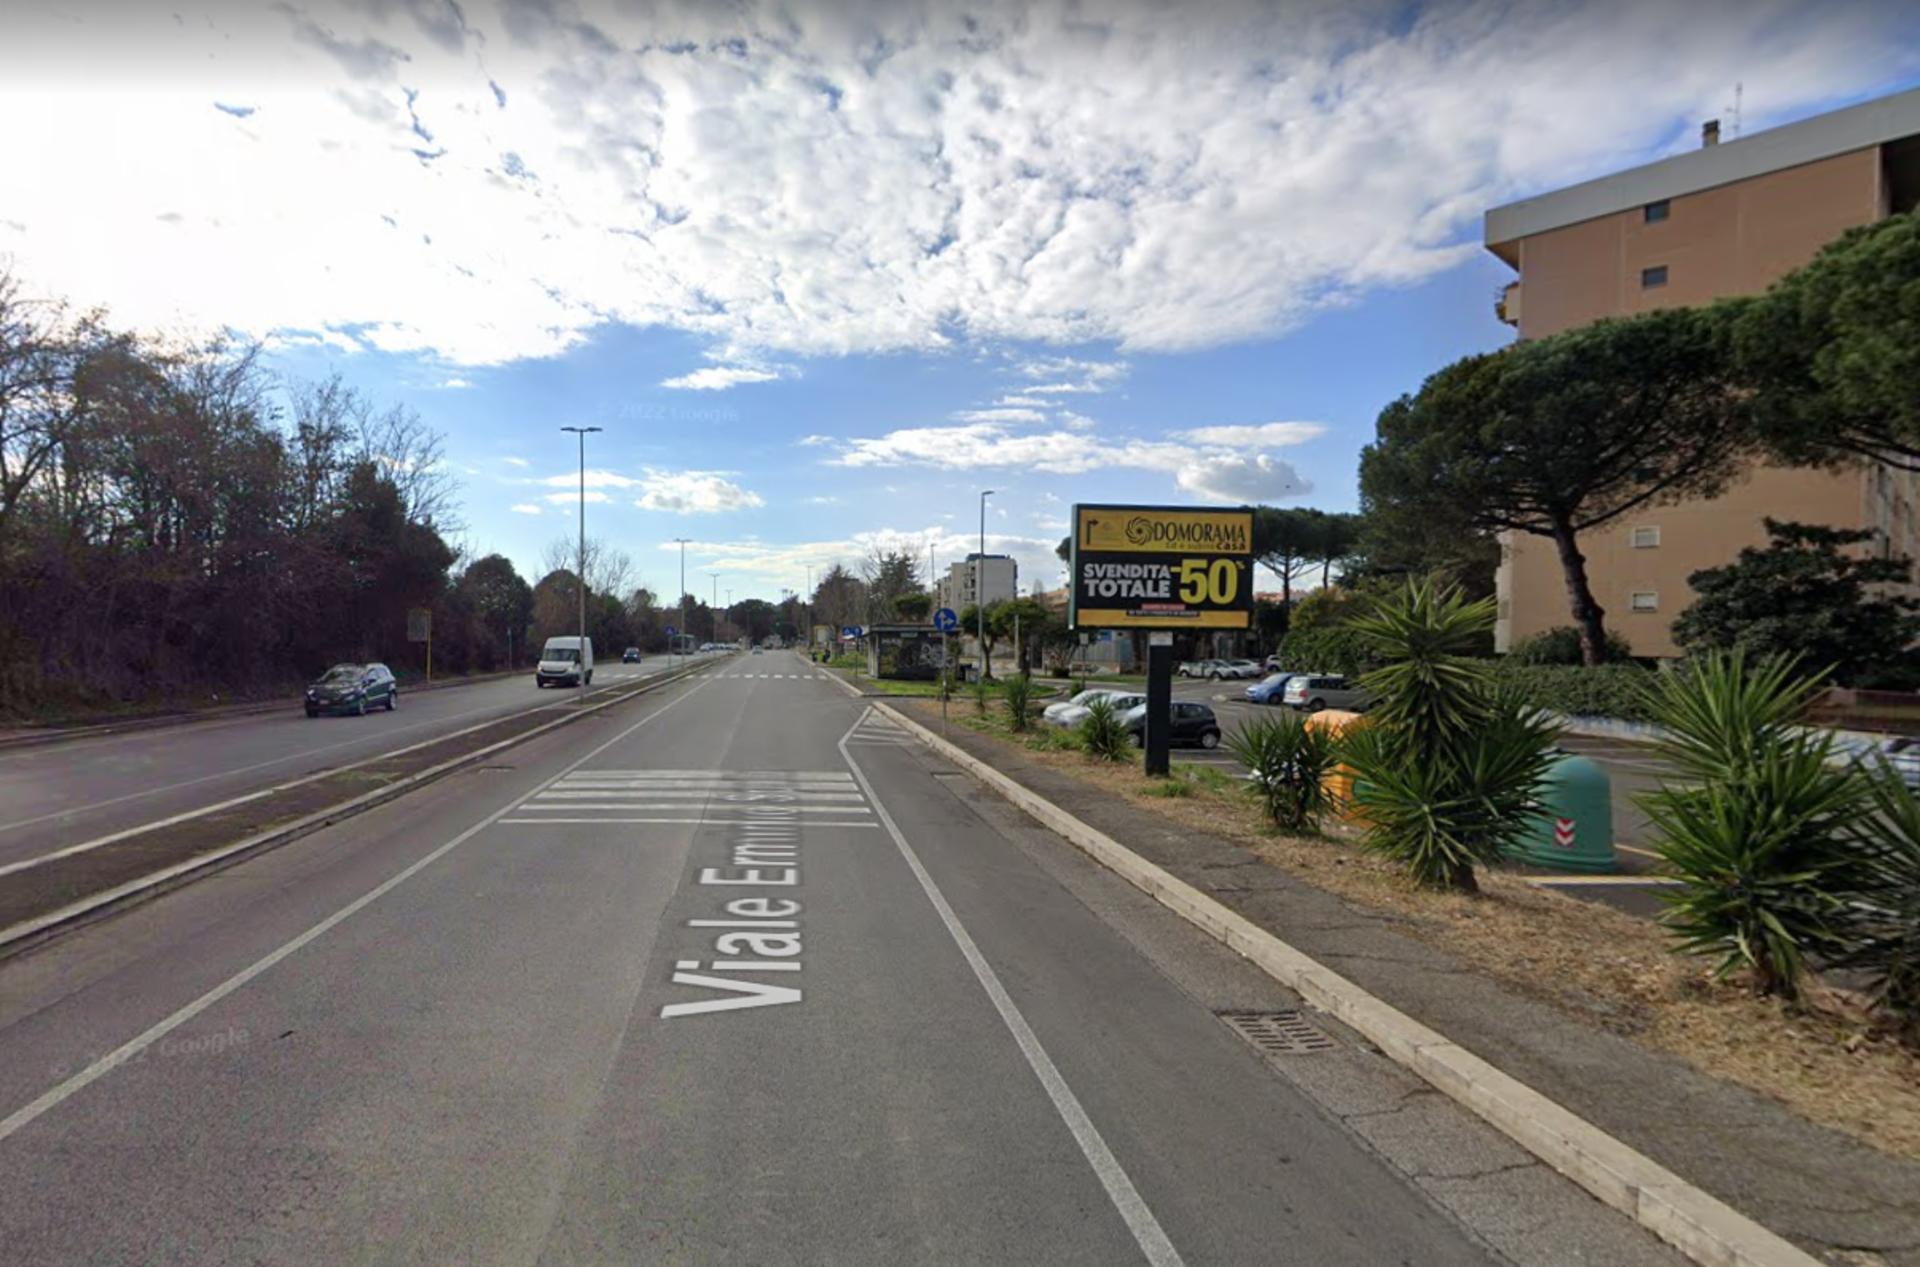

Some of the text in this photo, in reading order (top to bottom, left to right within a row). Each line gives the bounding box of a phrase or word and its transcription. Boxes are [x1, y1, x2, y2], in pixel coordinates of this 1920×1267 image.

[1153, 521, 1246, 543] DOMORAMA
[1083, 563, 1171, 580] SVENDITA
[1084, 579, 1170, 598] TOTALE
